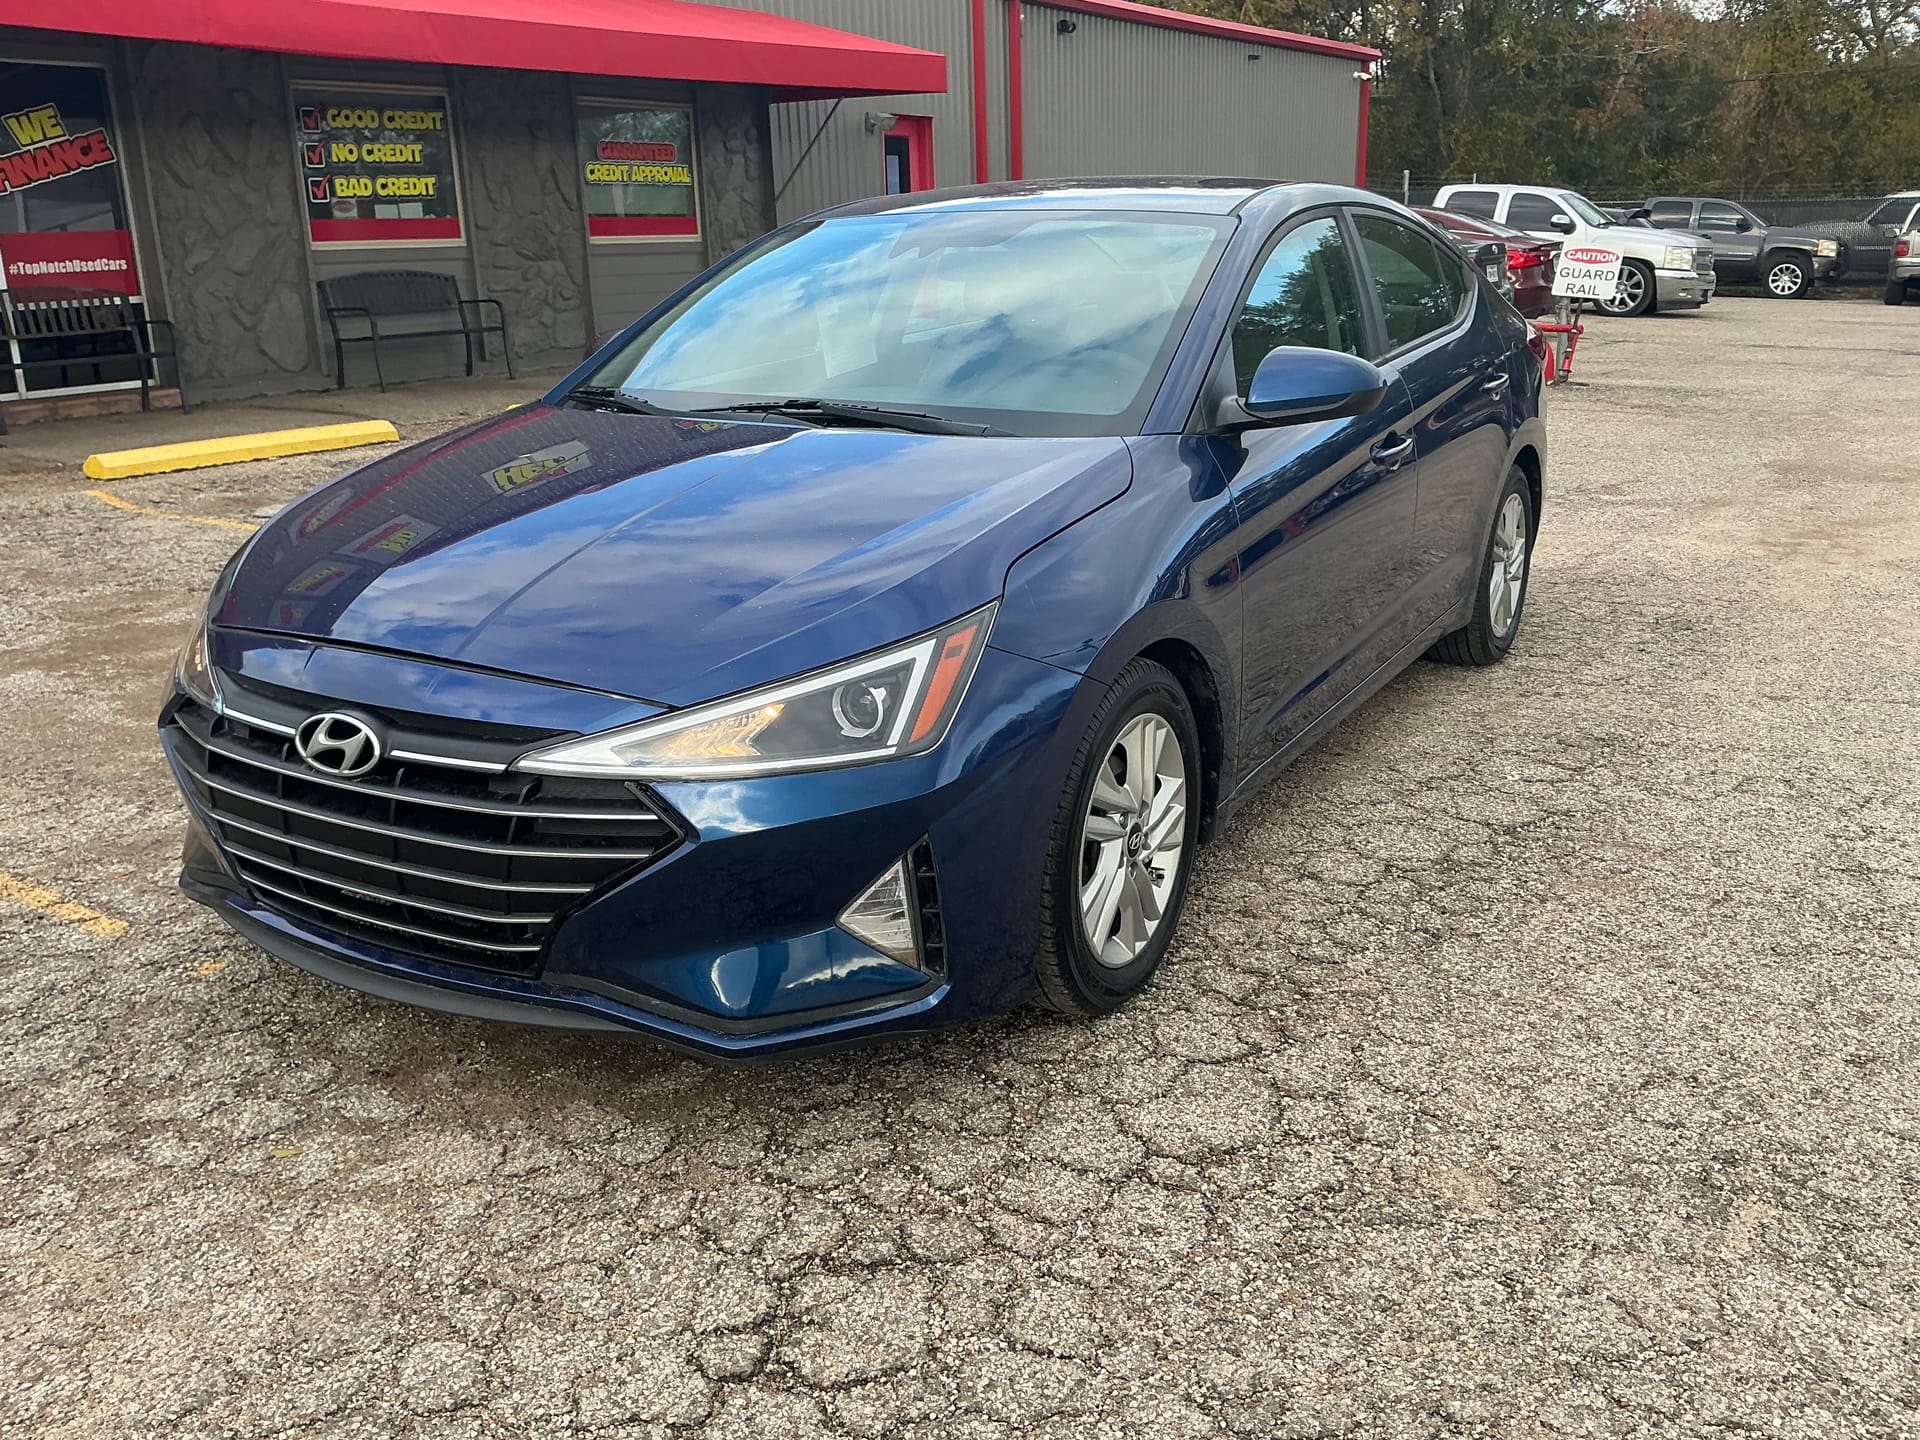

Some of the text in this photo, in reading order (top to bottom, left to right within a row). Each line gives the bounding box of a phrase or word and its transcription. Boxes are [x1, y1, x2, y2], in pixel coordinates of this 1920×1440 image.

[5, 105, 66, 146] WE
[326, 108, 443, 131] GOOD CREDIT
[331, 143, 423, 164] NO CREDIT
[600, 141, 676, 162] GUARANTEED
[586, 163, 692, 184] CREDIT APPROVAL
[335, 176, 437, 198] BAD CREDIT
[1566, 250, 1617, 262] CAUTION
[8, 258, 127, 276] #TopNotchUsedCars
[1559, 266, 1616, 281] GUARD
[1565, 282, 1601, 296] RAIL
